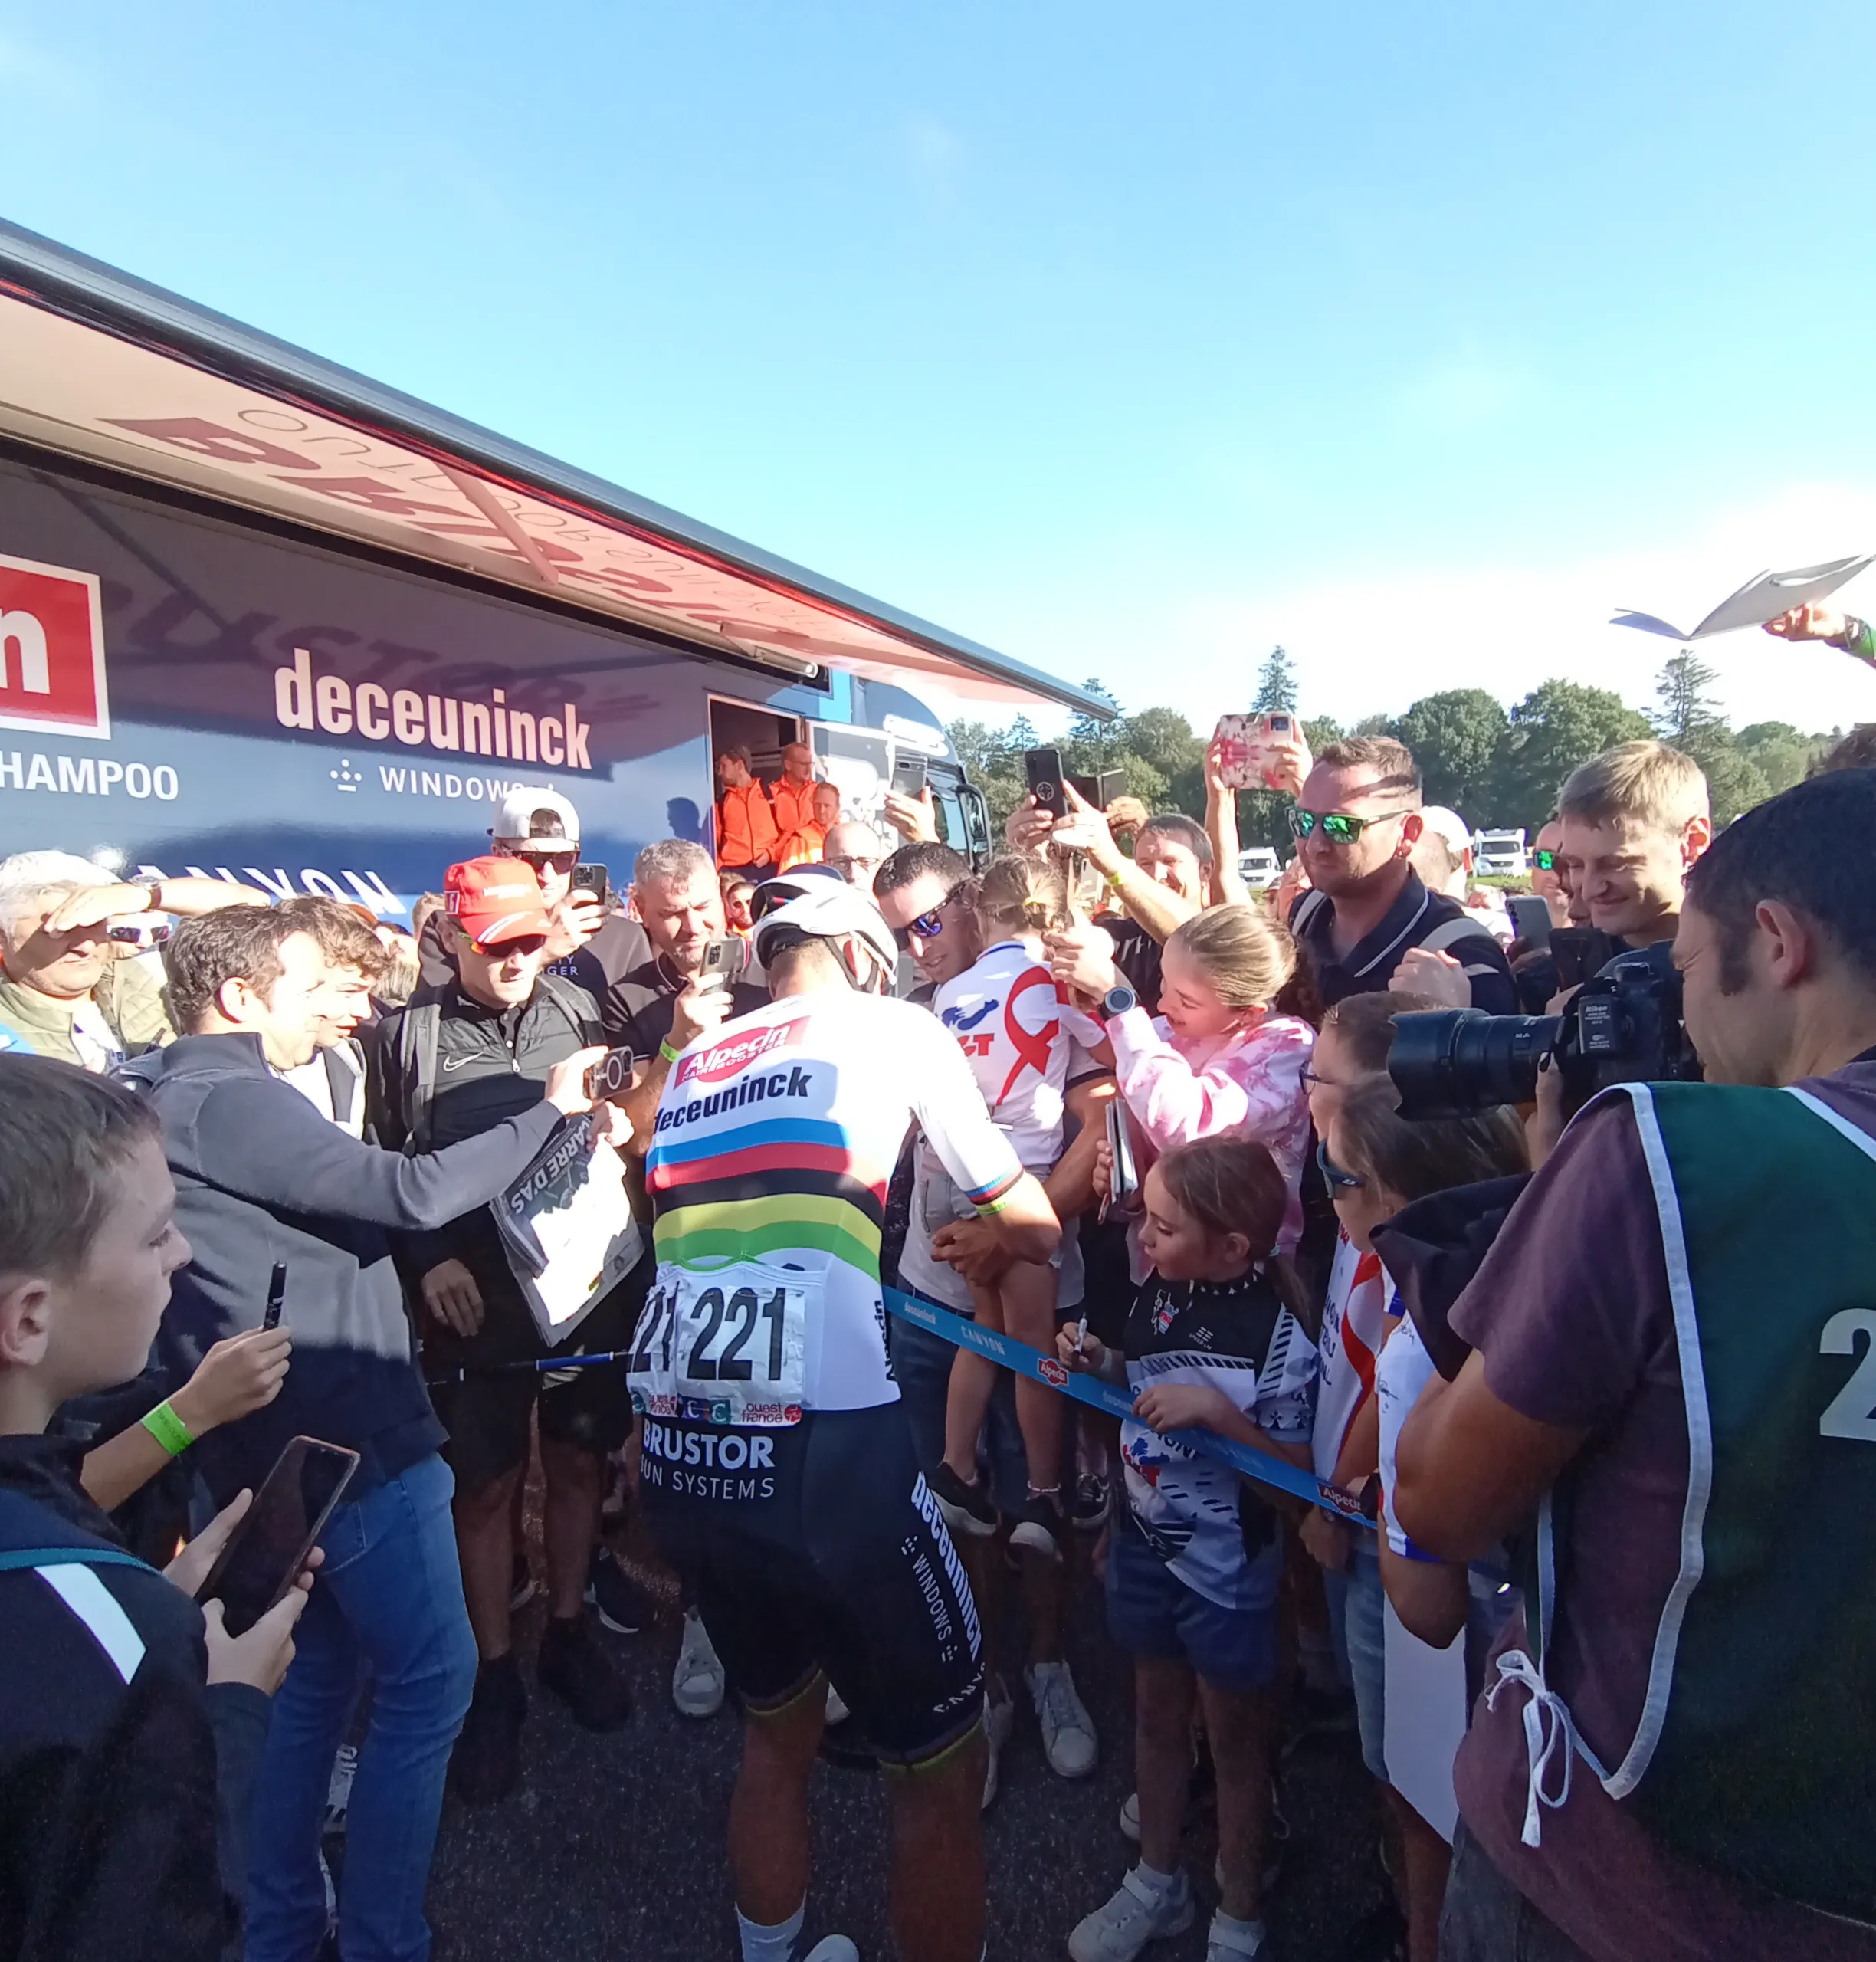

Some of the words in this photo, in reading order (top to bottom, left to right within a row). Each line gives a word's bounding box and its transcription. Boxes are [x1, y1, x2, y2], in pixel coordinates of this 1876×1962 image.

[274, 648, 592, 770] deceuninck
[684, 1025, 791, 1071] Alpecin
[687, 1287, 786, 1381] 221
[746, 1403, 782, 1414] ouest
[643, 1418, 776, 1470] BRUSTOR
[671, 1470, 776, 1500] SYSTEMS
[912, 1552, 953, 1642] WINDOWS
